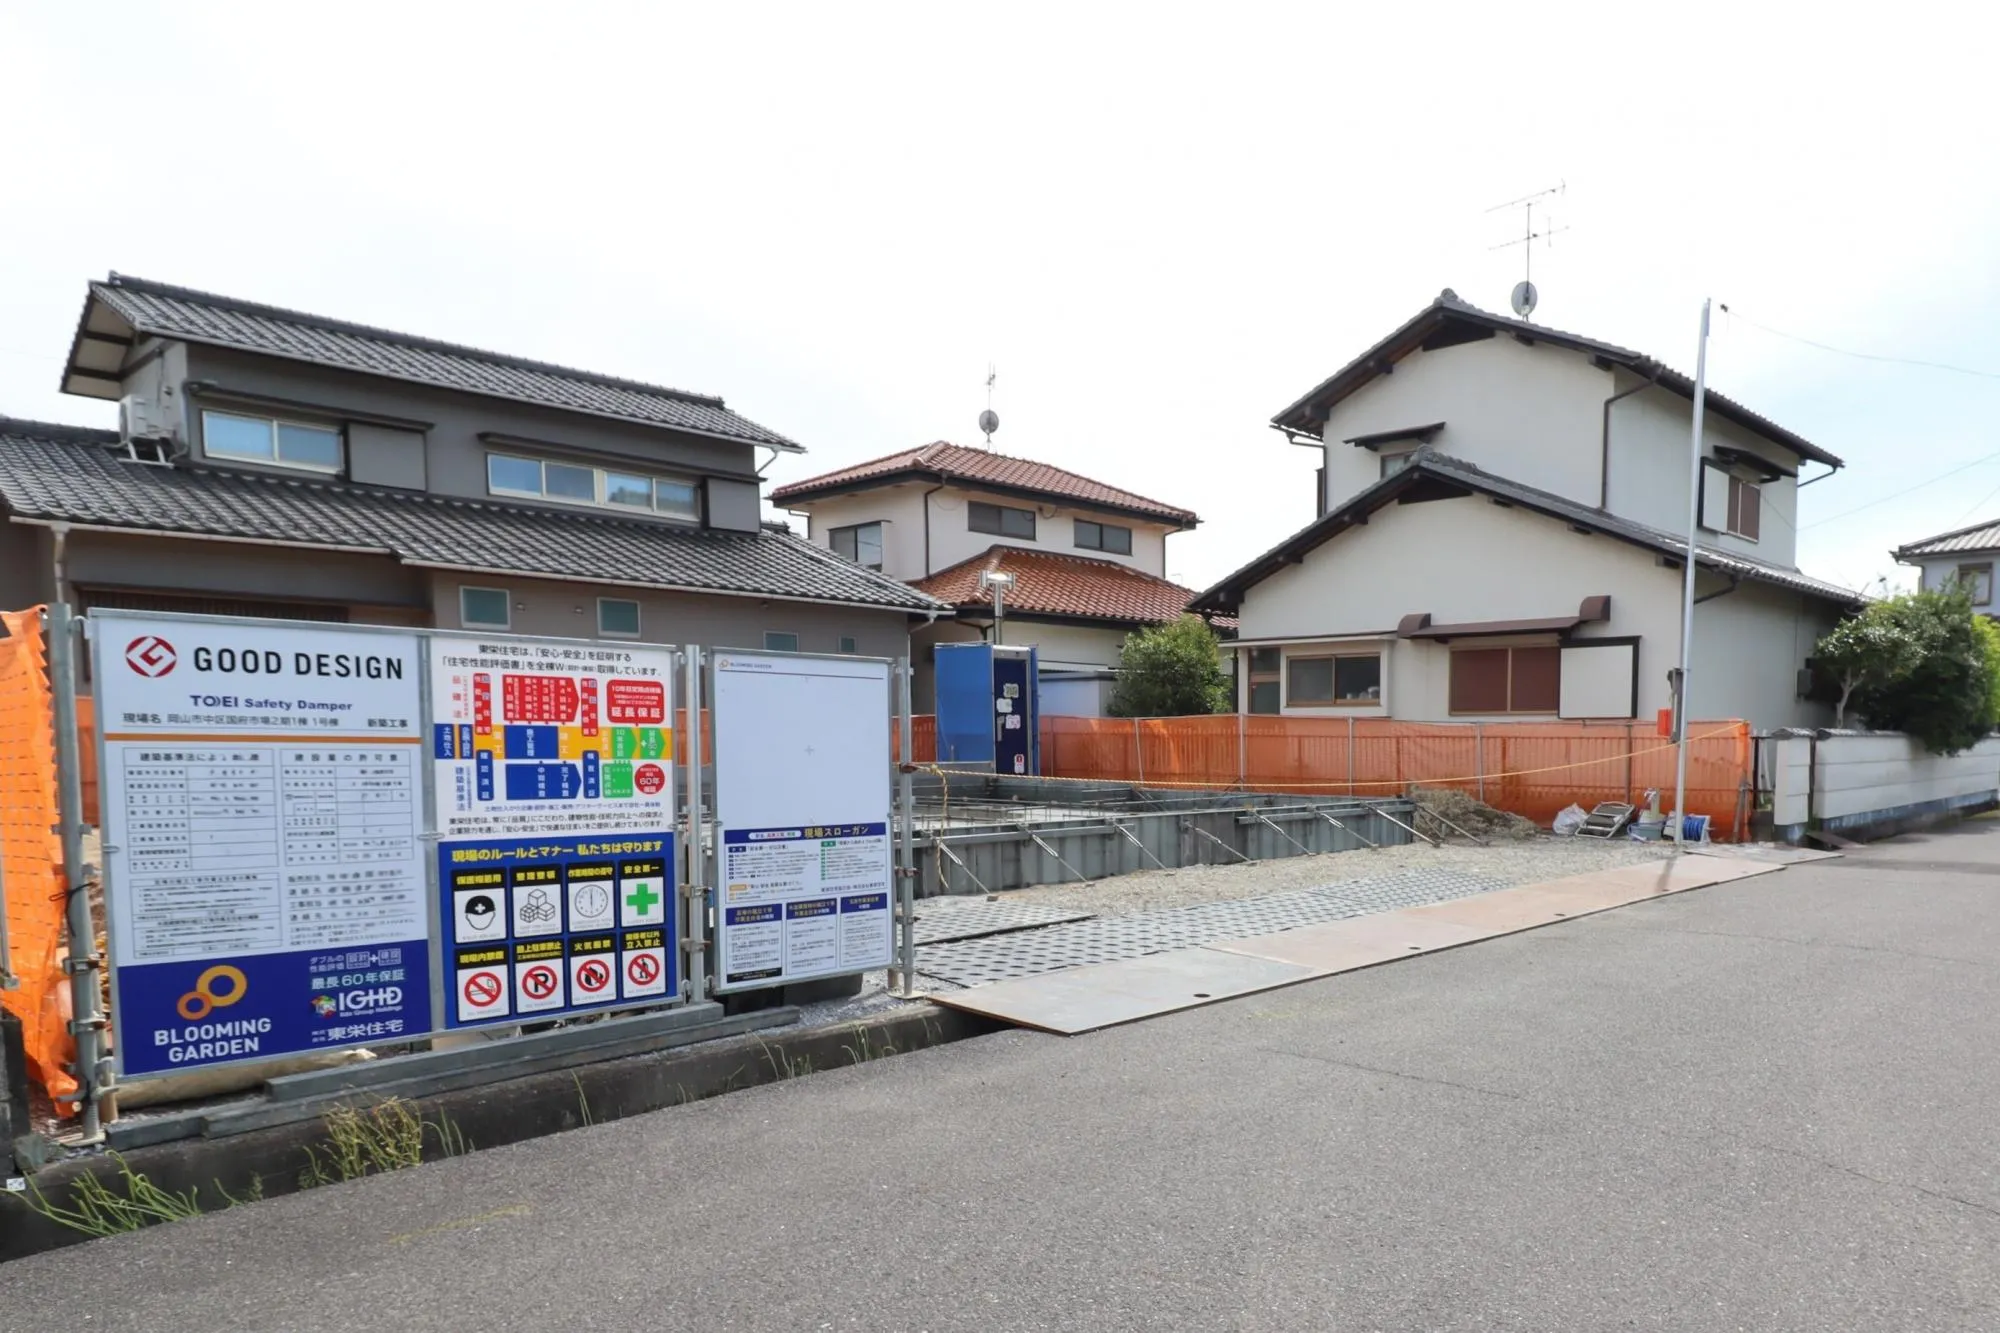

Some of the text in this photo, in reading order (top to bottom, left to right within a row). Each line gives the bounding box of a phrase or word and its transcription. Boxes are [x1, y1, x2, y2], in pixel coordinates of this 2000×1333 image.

[194, 647, 402, 680] GOOD DESIGN
[244, 698, 292, 711] Safety
[297, 700, 352, 712] Damper
[611, 706, 660, 718] 延長保証
[123, 713, 161, 724] 現場名
[367, 718, 408, 728] 新築工事
[804, 825, 869, 839] 現場スローガン
[452, 840, 663, 862] 現場のルールとマナー 私たちは守ります
[624, 864, 660, 875] 安全第一
[626, 938, 661, 950] 立入禁止
[311, 968, 405, 990] 最長60年保証
[154, 1017, 271, 1046] BLOOMING
[327, 1019, 404, 1041] 東栄住宅
[168, 1037, 259, 1063] GARDEN
